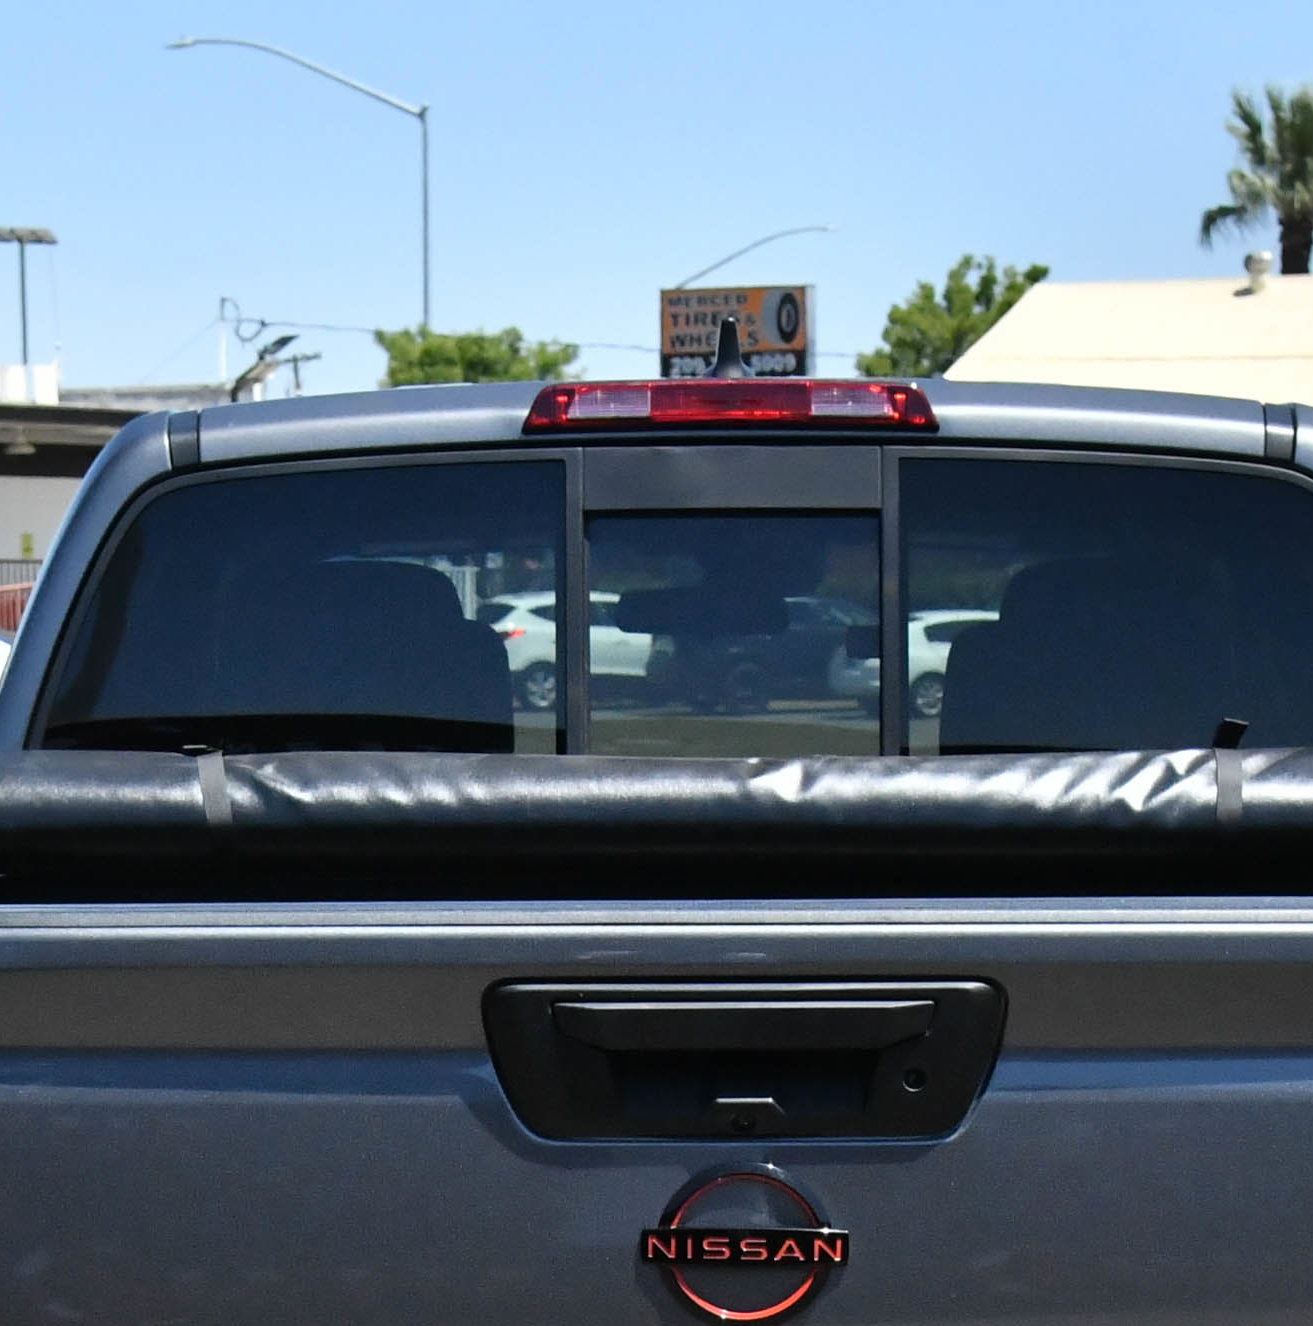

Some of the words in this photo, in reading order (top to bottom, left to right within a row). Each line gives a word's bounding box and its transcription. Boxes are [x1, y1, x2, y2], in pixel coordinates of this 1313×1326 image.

[669, 293, 748, 307] MERCED
[669, 331, 759, 349] WHES
[646, 1235, 842, 1262] NISSAN
